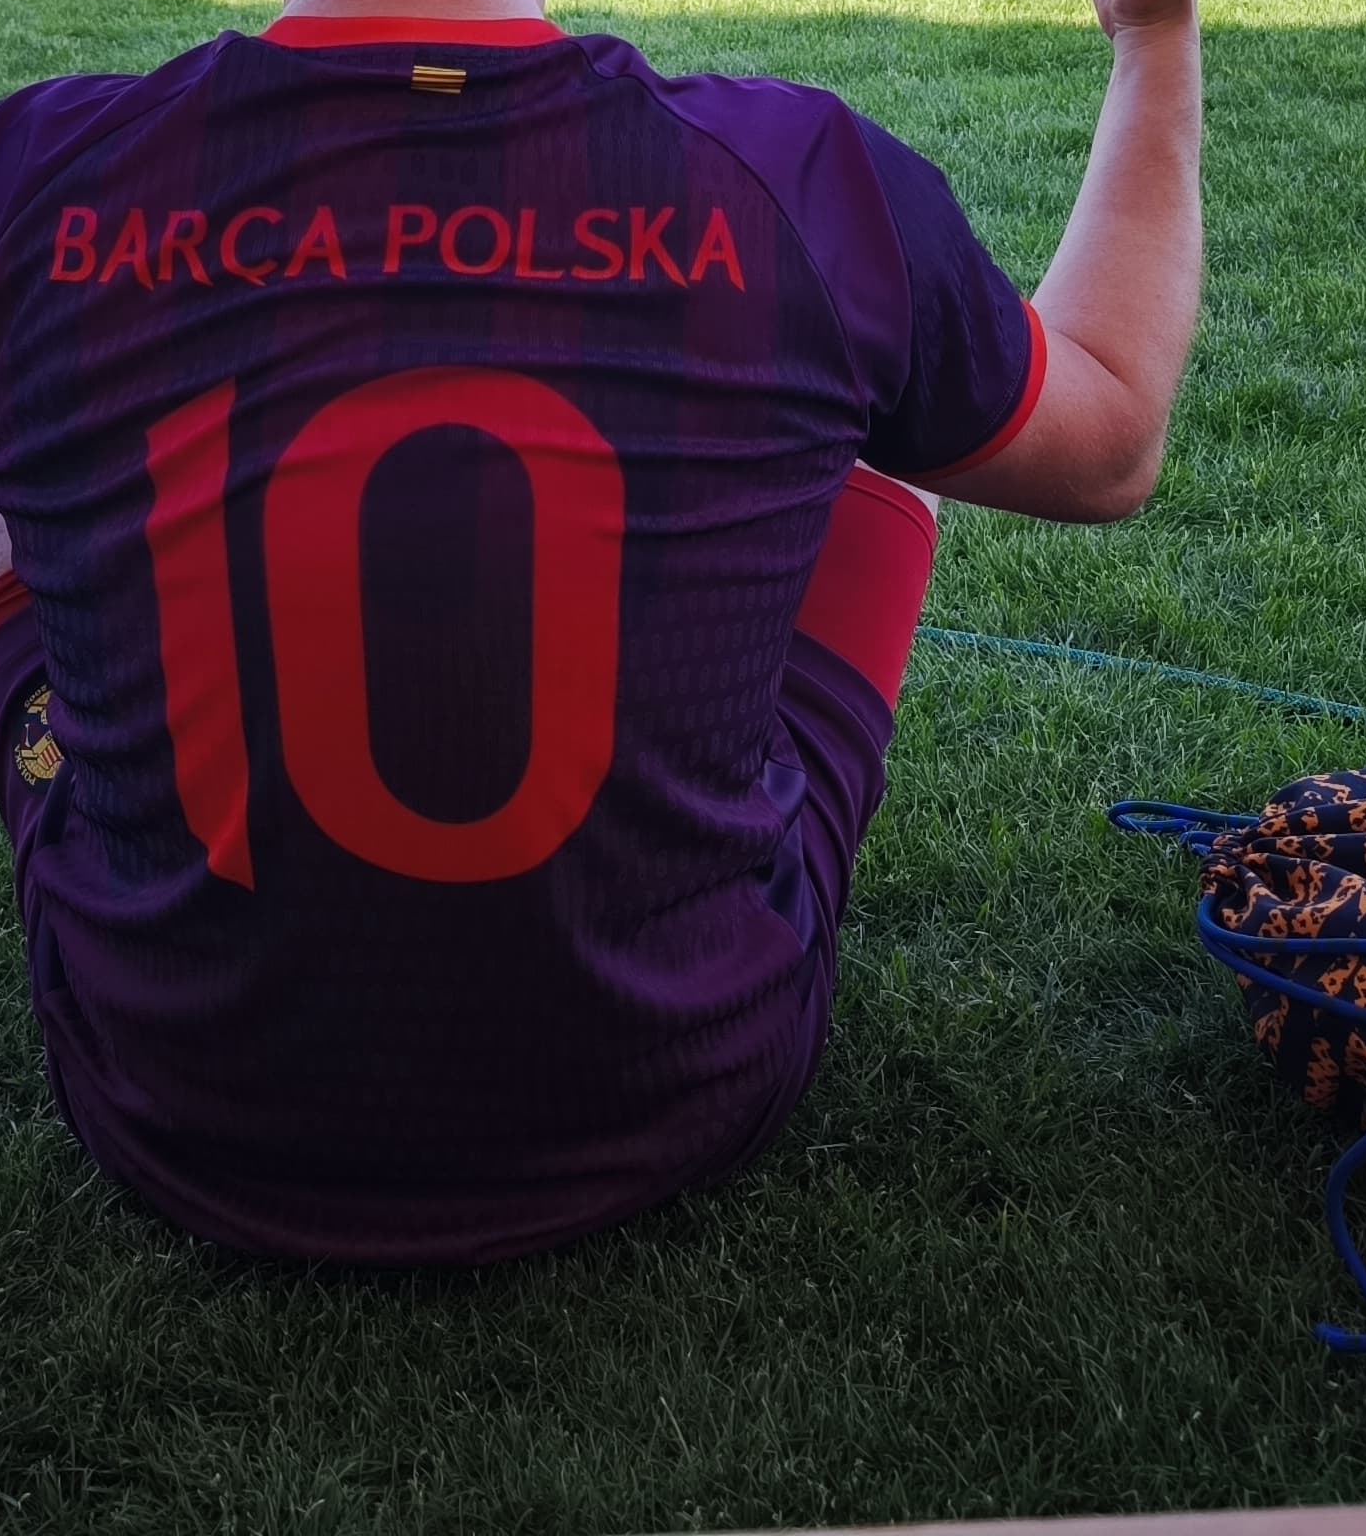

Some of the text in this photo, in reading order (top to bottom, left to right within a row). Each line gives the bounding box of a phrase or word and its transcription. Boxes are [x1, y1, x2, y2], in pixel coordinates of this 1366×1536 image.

[49, 204, 746, 292] BARÇA POLSKA
[145, 365, 626, 893] 10
